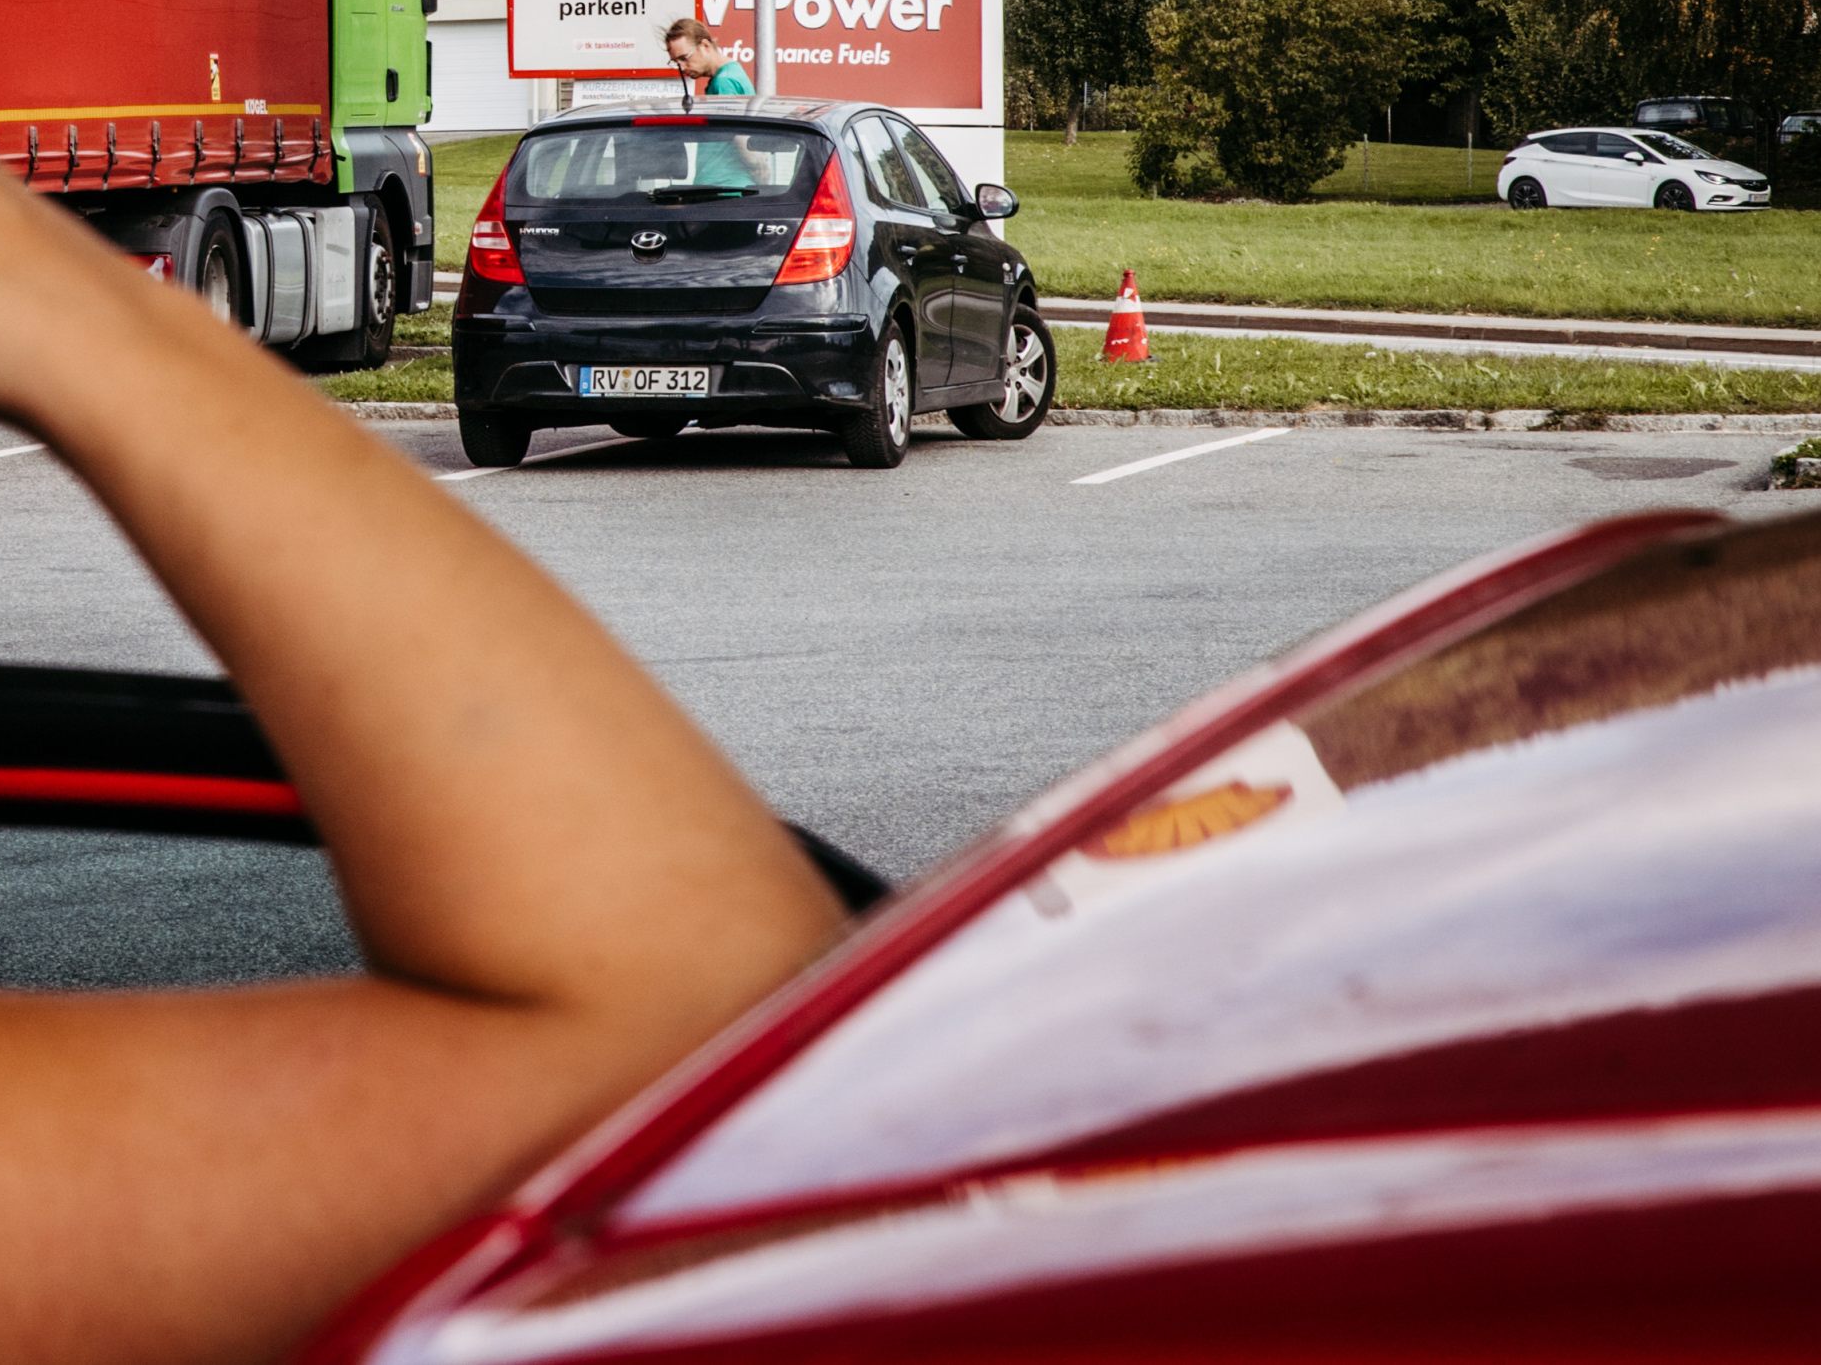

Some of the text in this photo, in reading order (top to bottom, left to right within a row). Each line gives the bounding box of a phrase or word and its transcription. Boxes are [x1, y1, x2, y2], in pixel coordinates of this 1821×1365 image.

[838, 42, 890, 65] Fuels
[593, 370, 705, 391] RV OF 312
